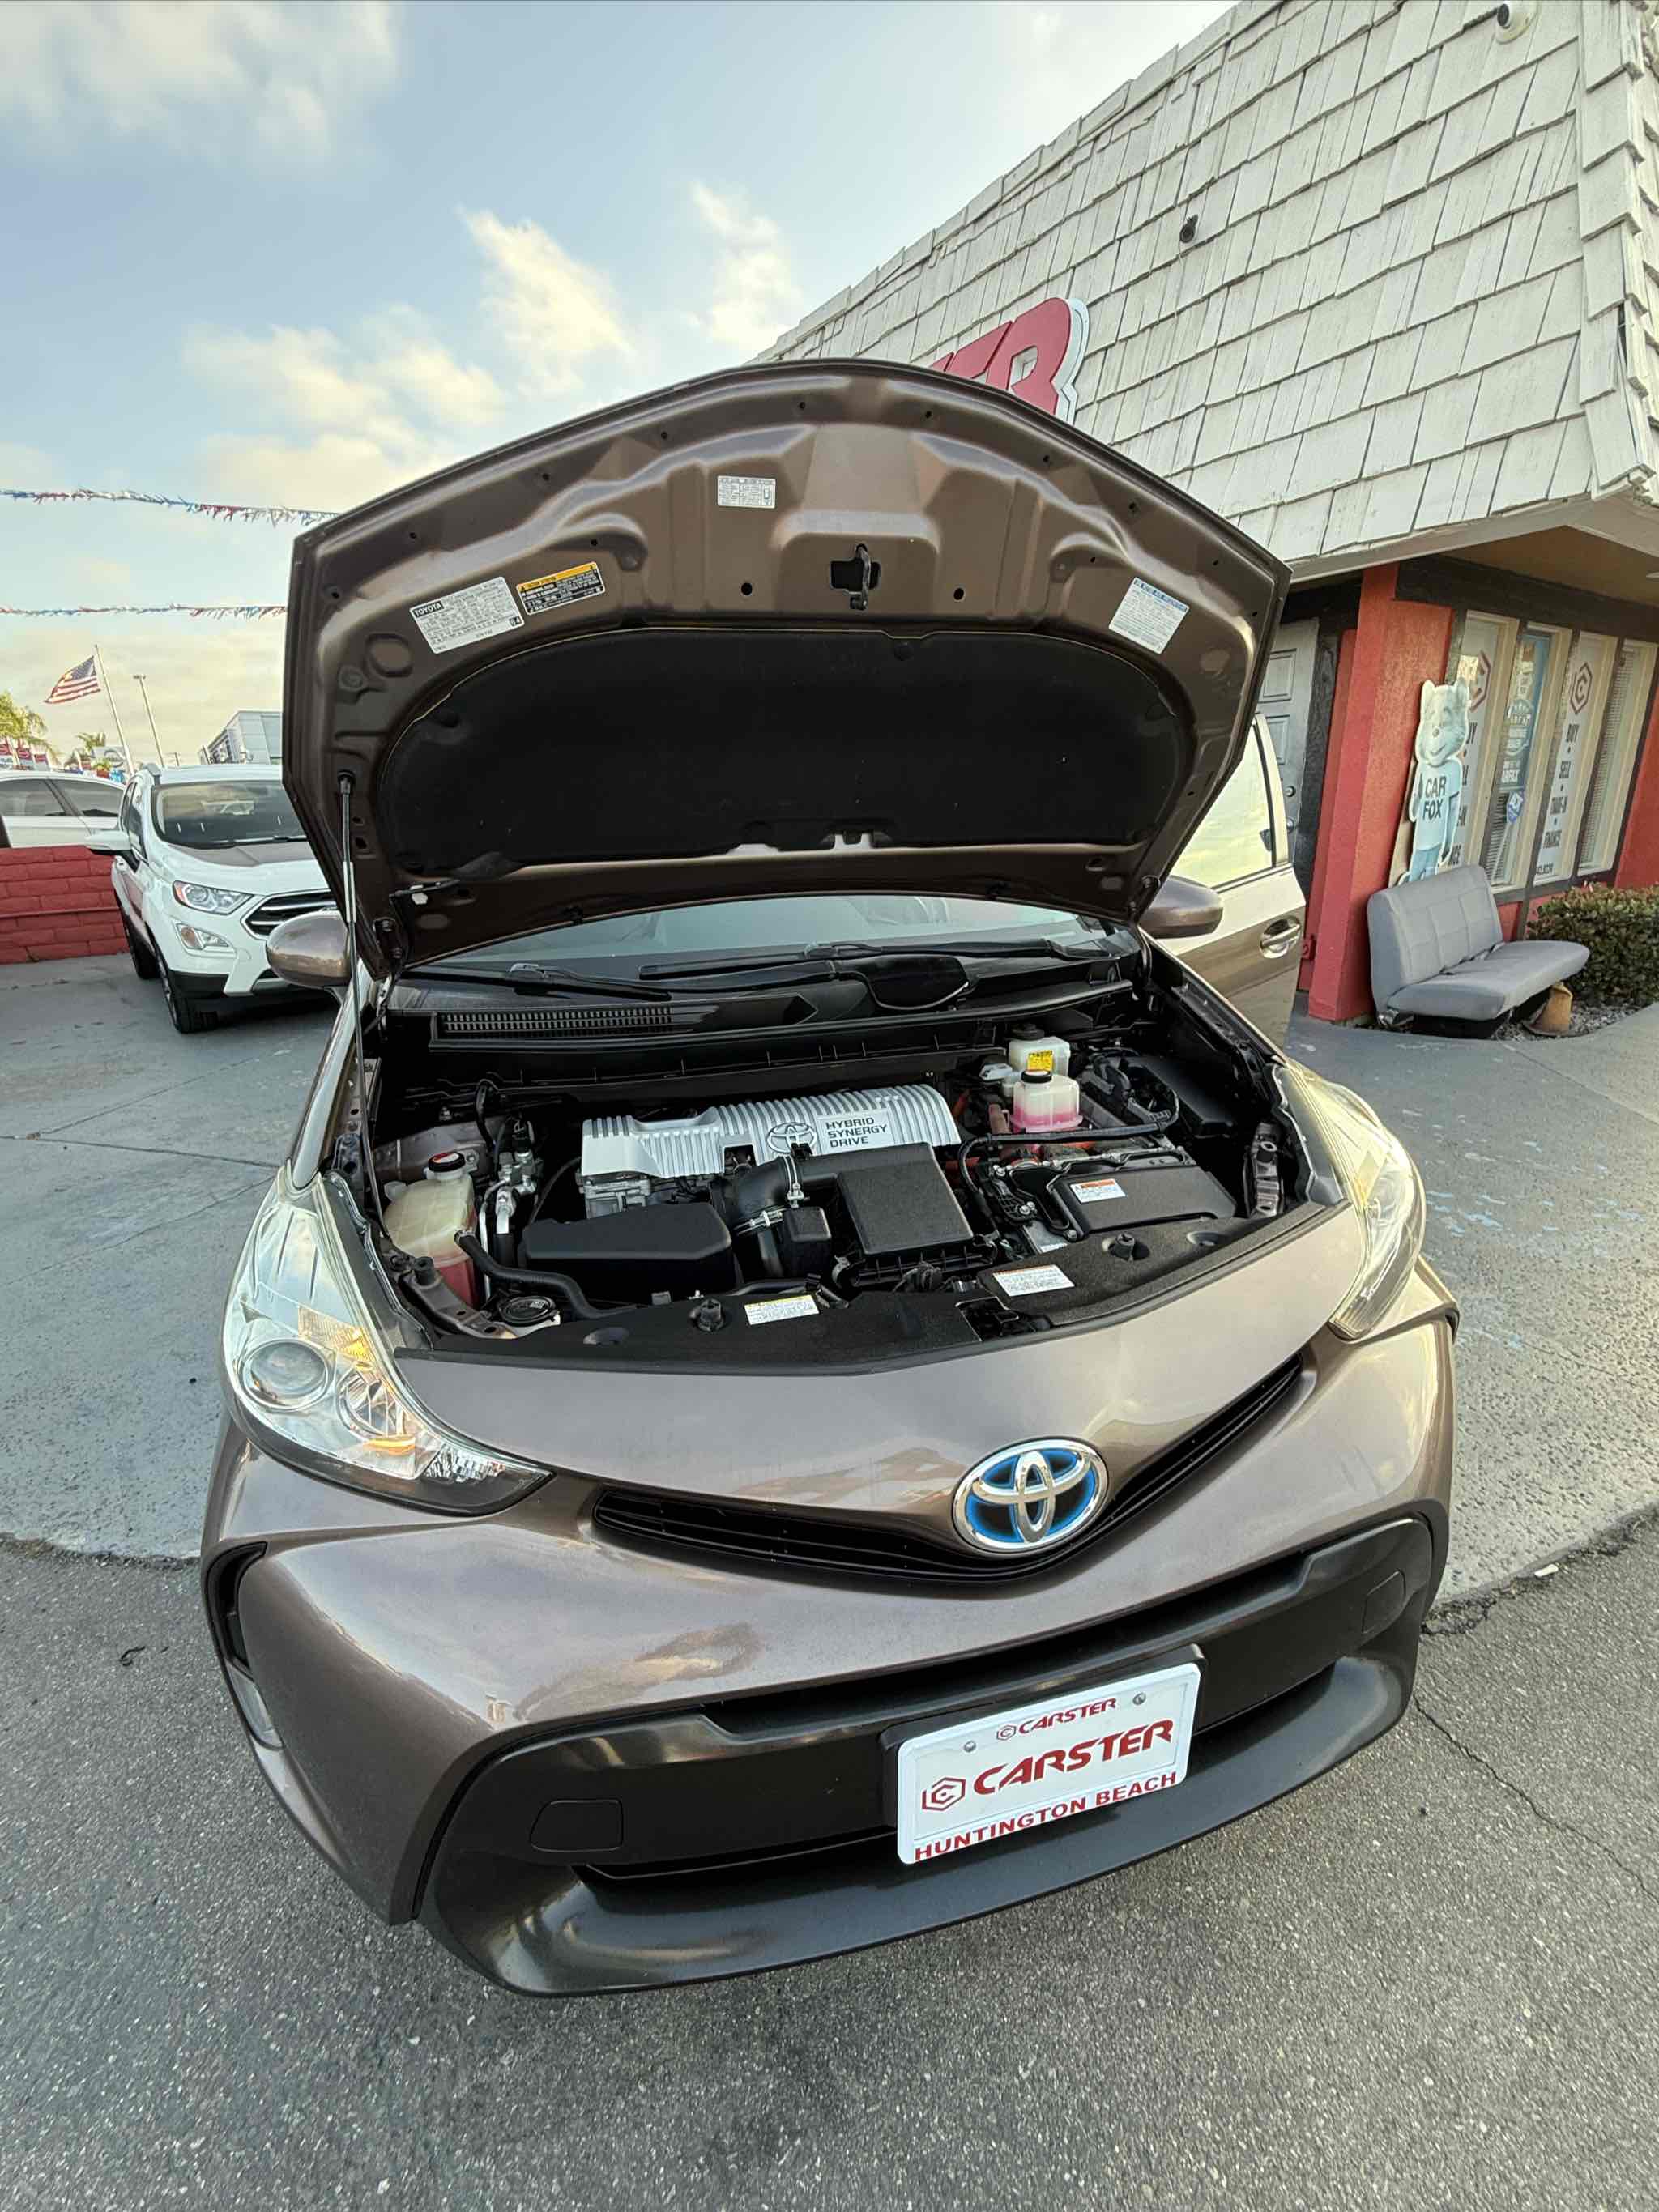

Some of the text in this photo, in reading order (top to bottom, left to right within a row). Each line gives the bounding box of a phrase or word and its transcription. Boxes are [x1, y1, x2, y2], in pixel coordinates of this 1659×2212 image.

[414, 602, 443, 616] TOYOTA
[1425, 775, 1447, 798] CAR
[1422, 799, 1443, 820] FOX
[825, 1117, 874, 1130] HYBRID
[828, 1124, 887, 1139] SYNERGY
[830, 1136, 868, 1148] DRIVE
[1018, 1698, 1116, 1734] CARSTER
[973, 1719, 1174, 1795] CARSTER
[914, 1771, 1176, 1861] HUNTINGTON BEACH
